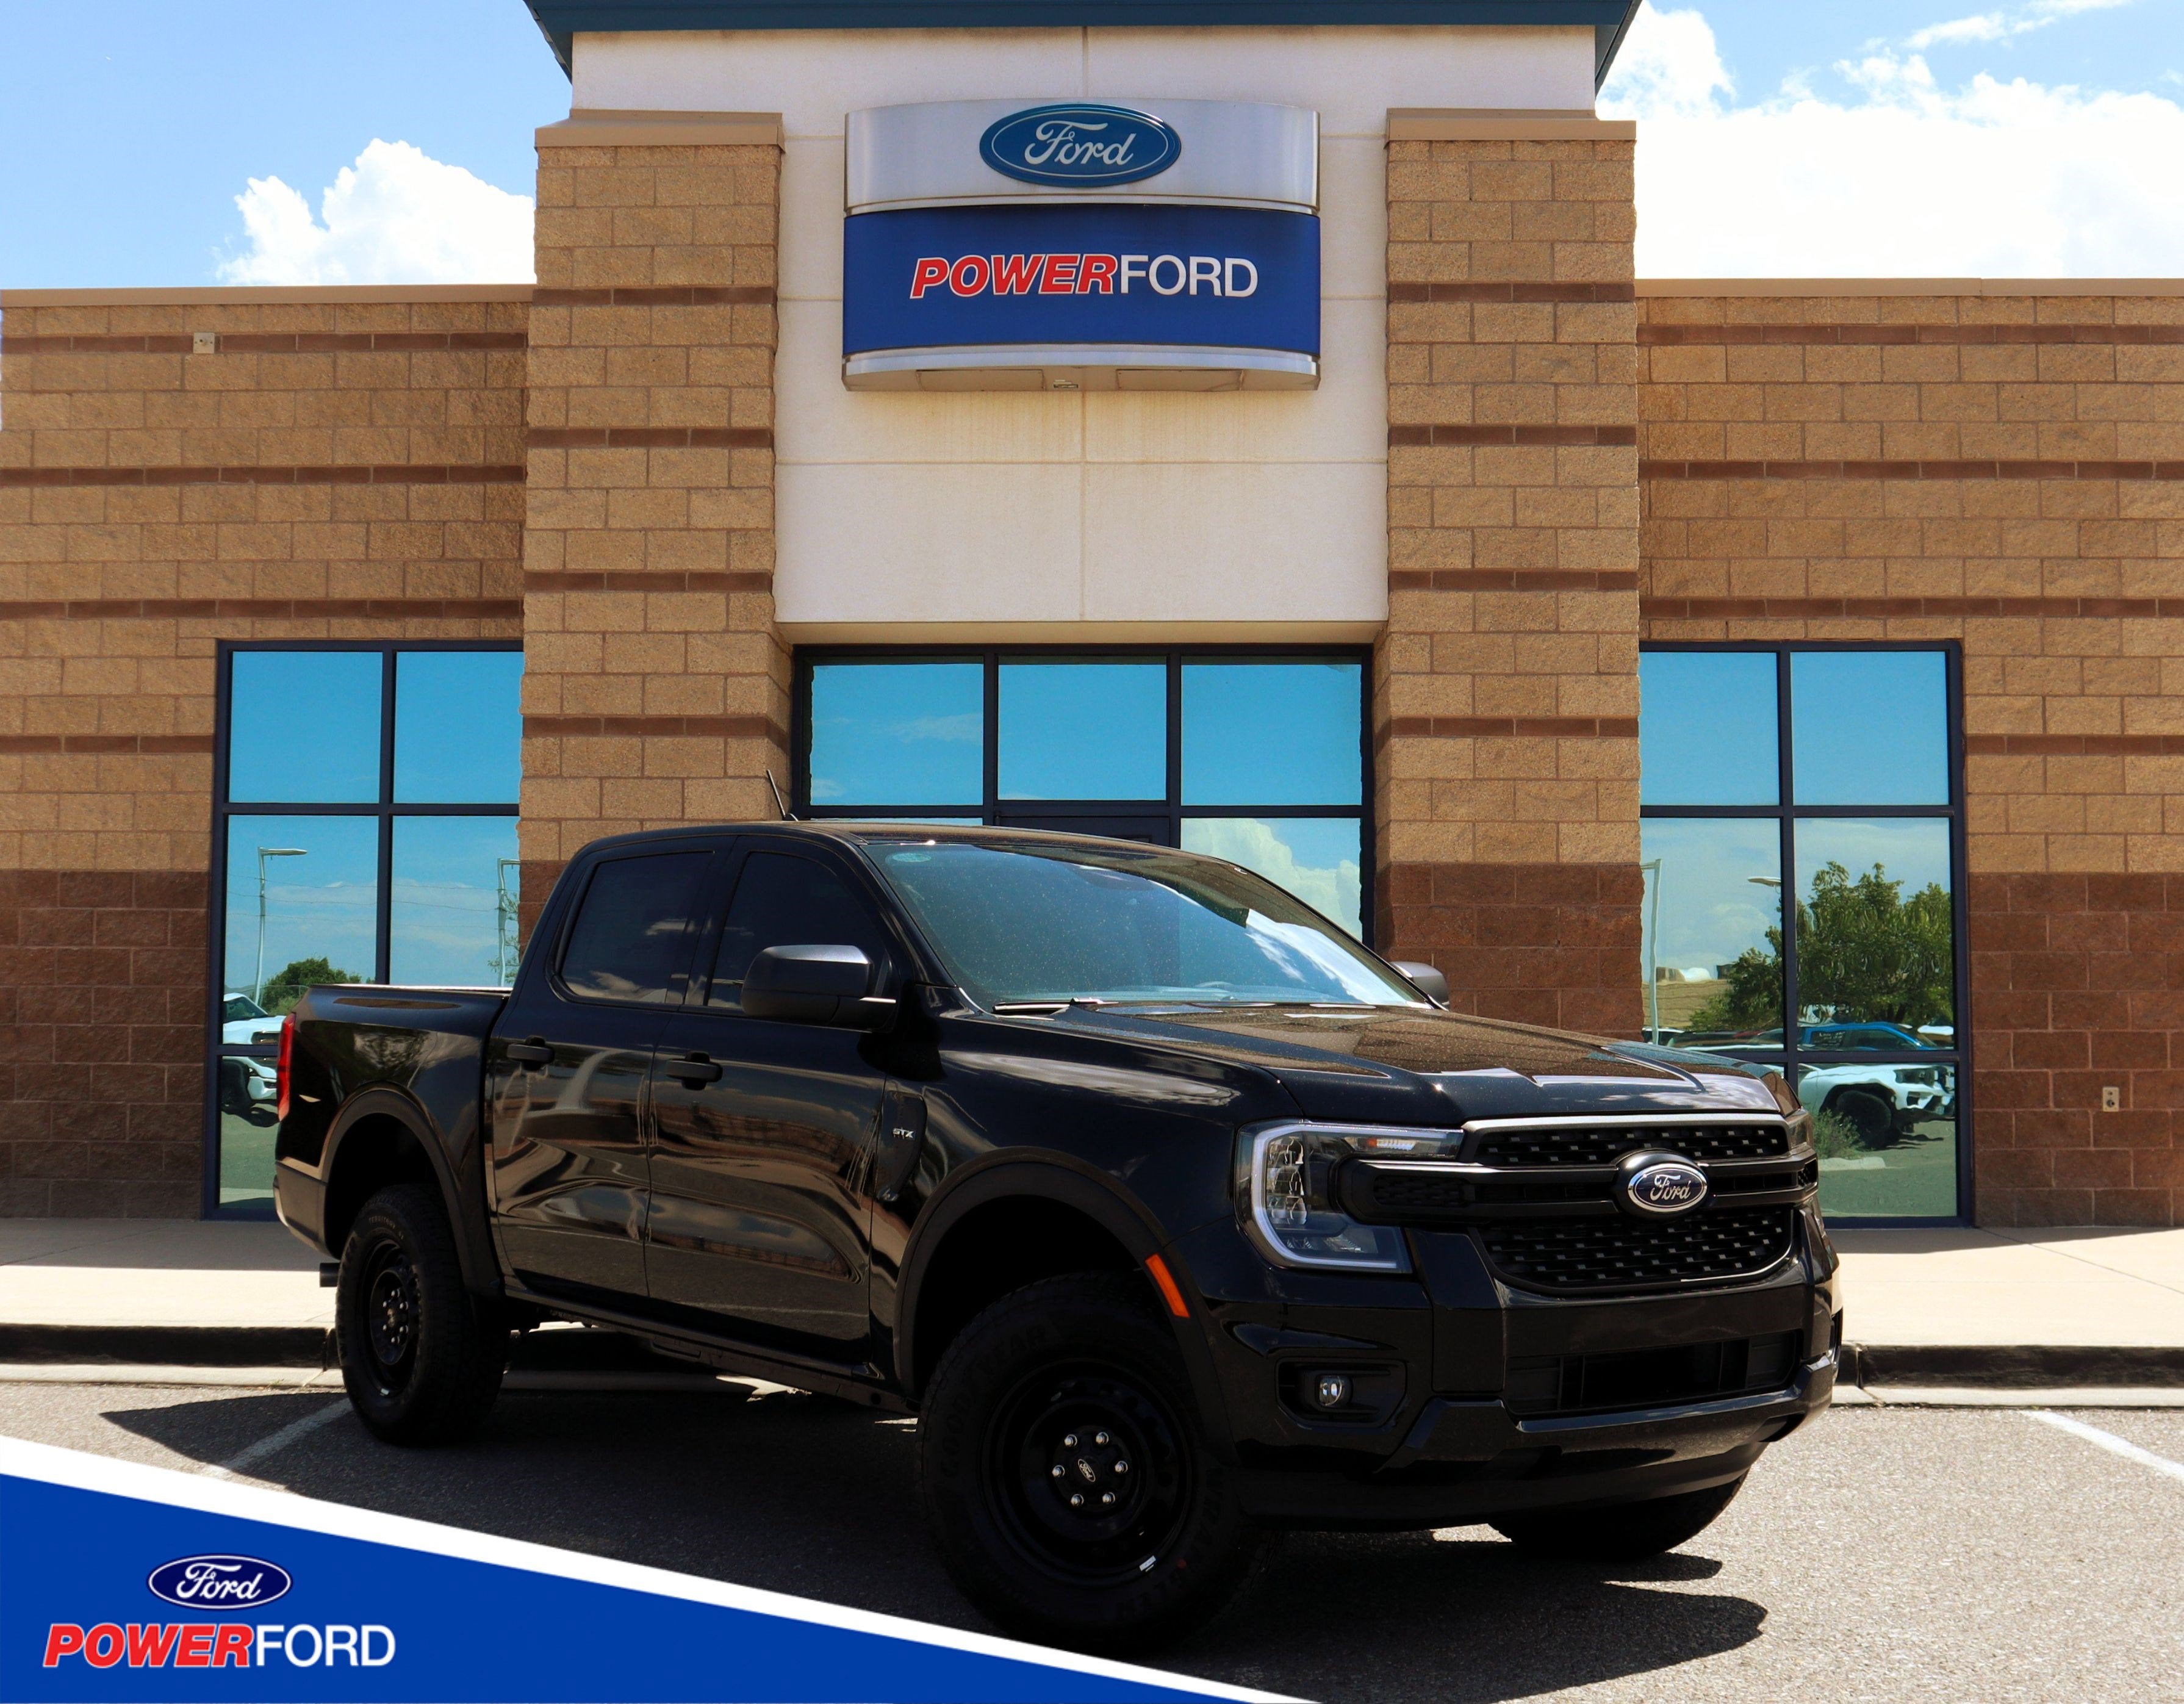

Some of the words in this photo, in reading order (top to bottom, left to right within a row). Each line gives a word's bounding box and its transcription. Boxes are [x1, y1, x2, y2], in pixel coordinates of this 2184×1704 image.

[1024, 120, 1136, 165] Ford
[910, 253, 1259, 300] POWERFORD
[893, 1127, 914, 1139] STX
[1650, 1174, 1691, 1201] Ford
